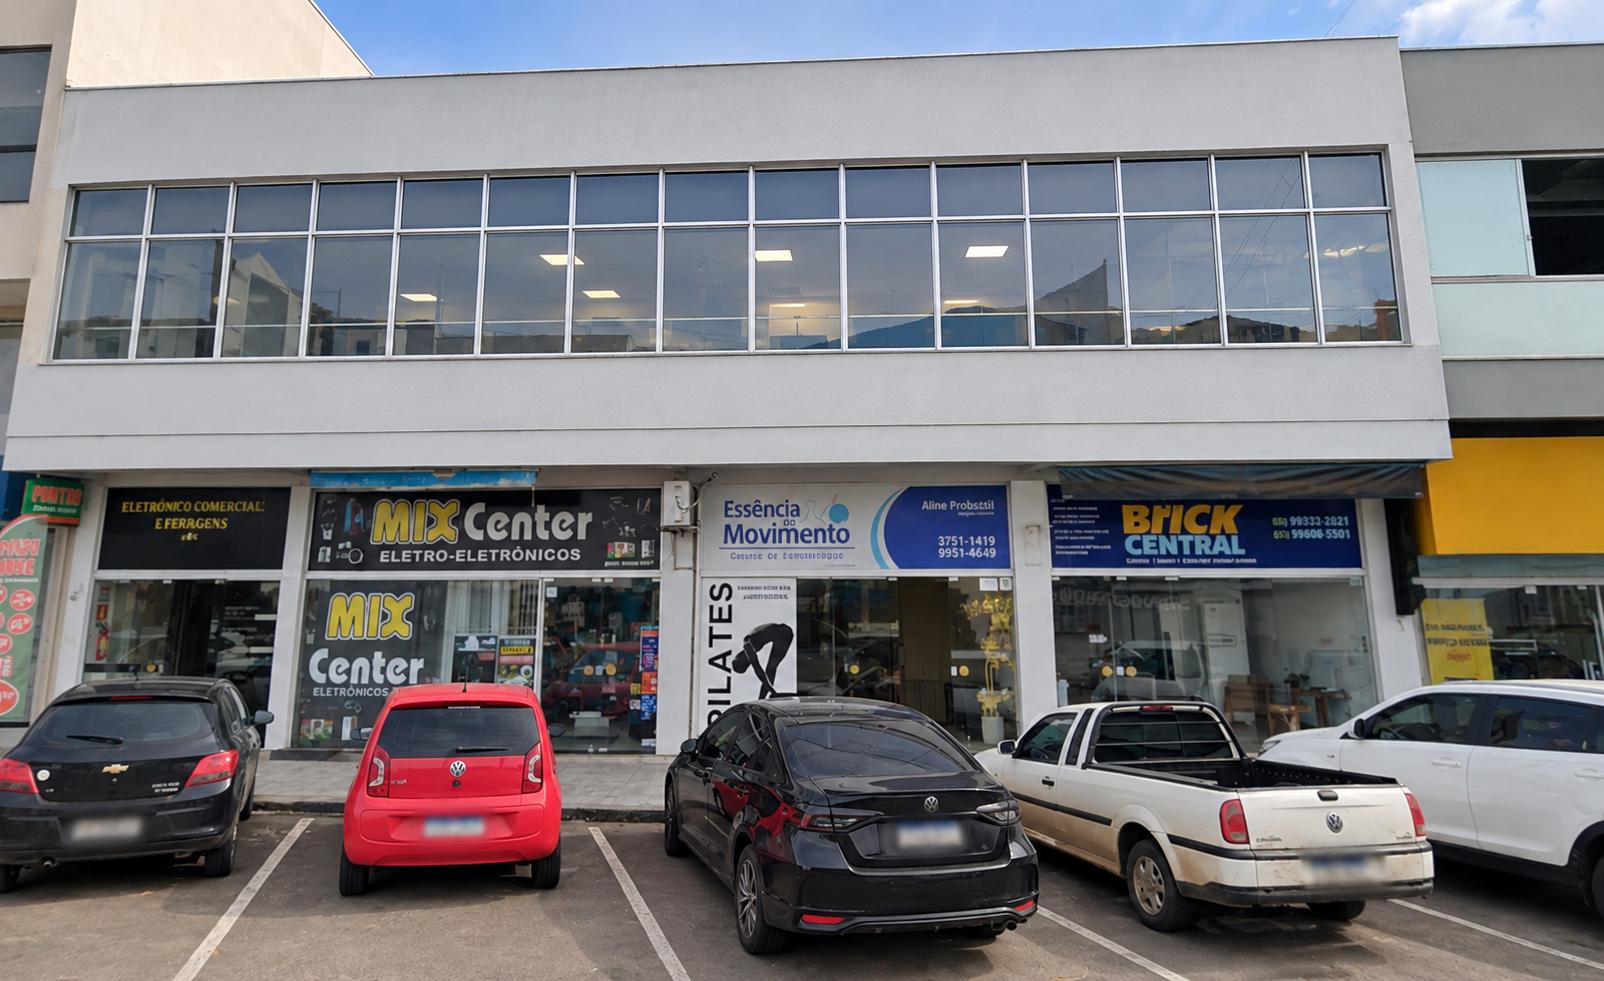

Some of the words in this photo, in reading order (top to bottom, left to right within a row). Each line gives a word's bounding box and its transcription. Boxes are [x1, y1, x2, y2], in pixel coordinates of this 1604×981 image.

[723, 499, 800, 518] Essência
[921, 500, 947, 511] Aline
[155, 517, 163, 529] E
[371, 499, 460, 544] MIX
[463, 502, 593, 541] Center
[723, 522, 850, 545] Movimento
[938, 535, 996, 546] 3751-1419
[938, 547, 997, 558] 9951-4649
[1124, 534, 1246, 556] CENTRAL
[325, 592, 415, 641] MIX
[308, 647, 425, 685] Center
